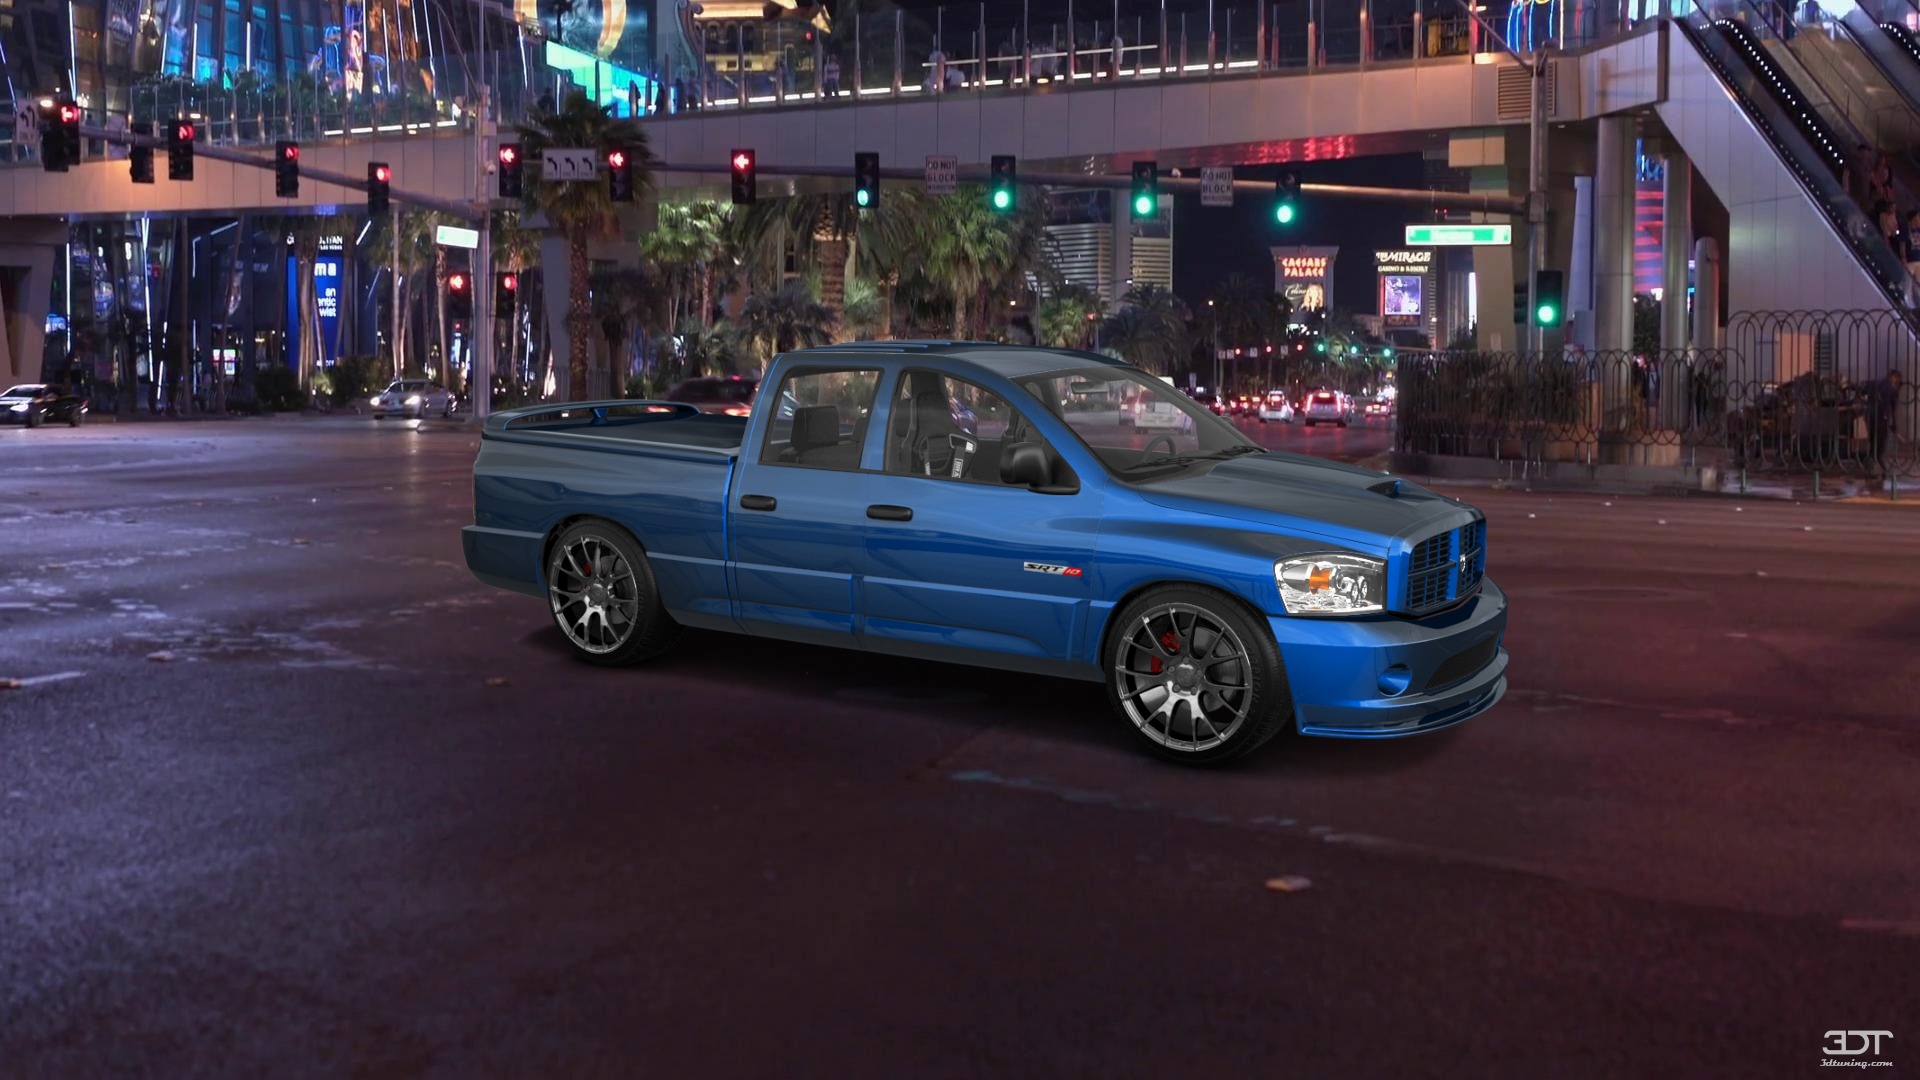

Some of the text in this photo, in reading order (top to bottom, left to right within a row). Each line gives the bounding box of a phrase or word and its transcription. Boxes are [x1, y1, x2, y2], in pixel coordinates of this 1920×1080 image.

[1281, 257, 1327, 268] CAESARS
[1381, 251, 1431, 263] MIRAGE
[1284, 267, 1324, 277] PALACE
